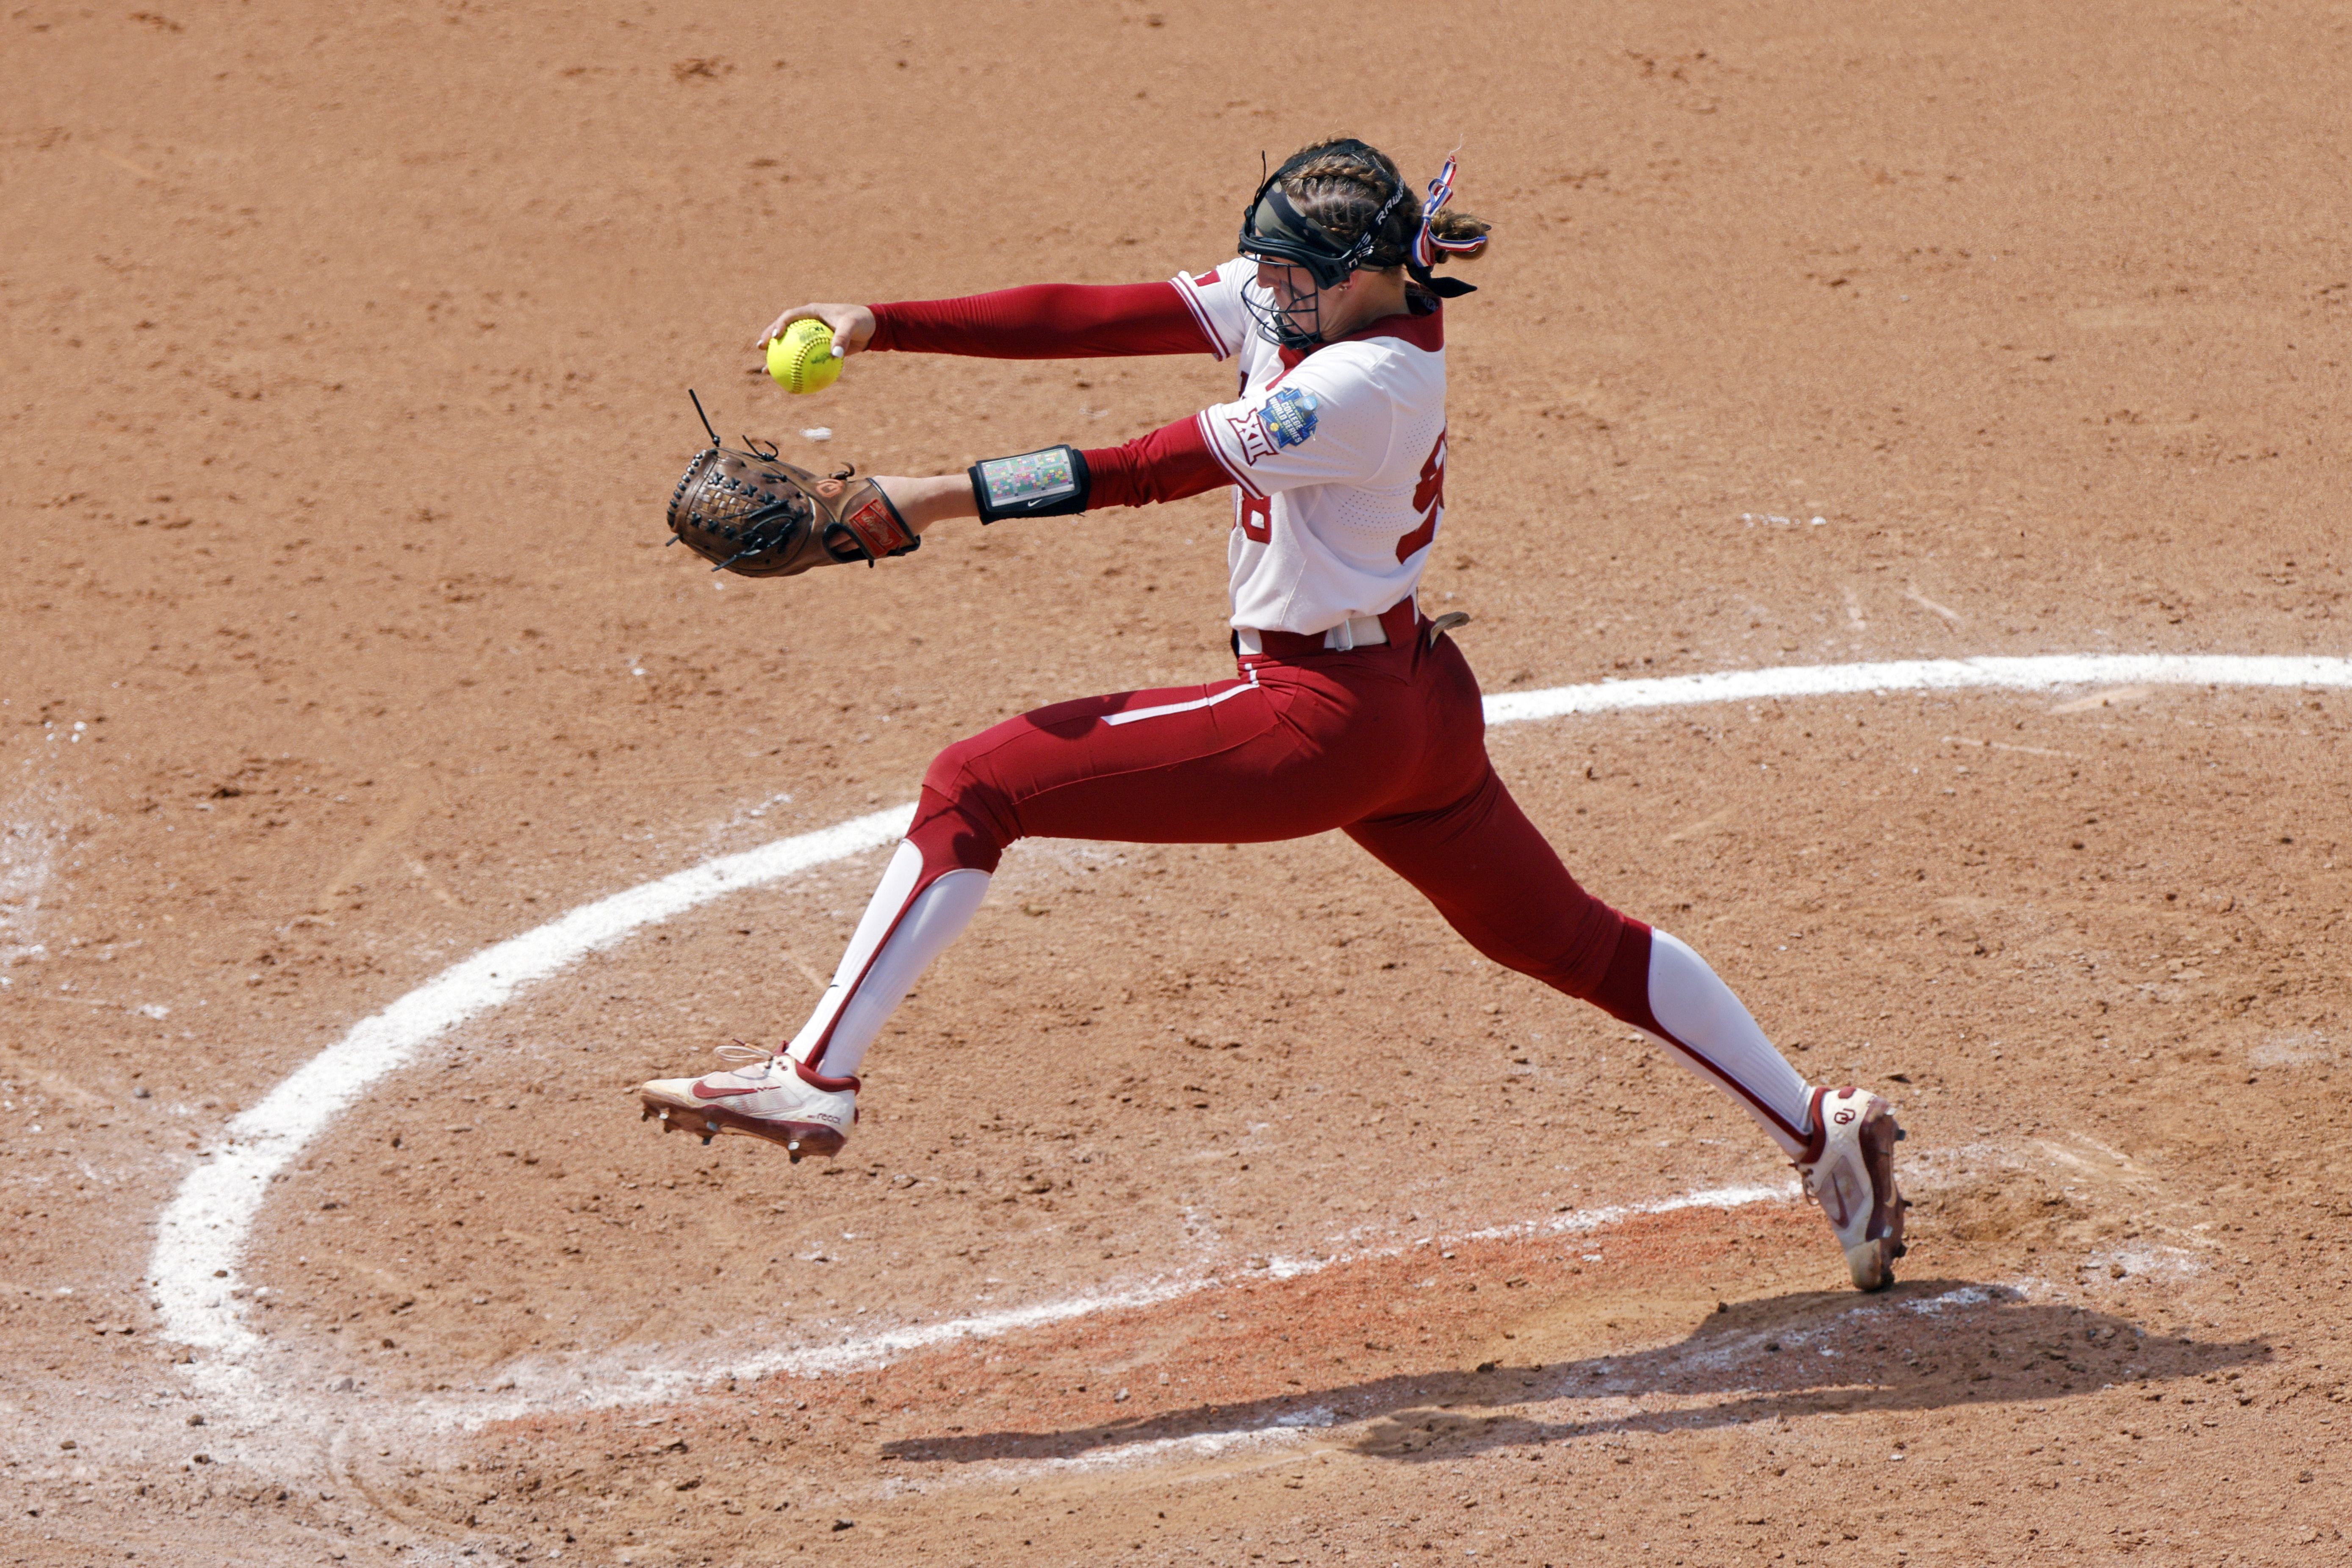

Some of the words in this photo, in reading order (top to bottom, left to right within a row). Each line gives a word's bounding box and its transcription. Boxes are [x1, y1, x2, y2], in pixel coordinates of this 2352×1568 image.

[1269, 396, 1288, 421] WORLD
[1283, 419, 1303, 443] SERIES
[1281, 402, 1304, 430] COLLEGE
[1834, 1108, 1856, 1125] OU
